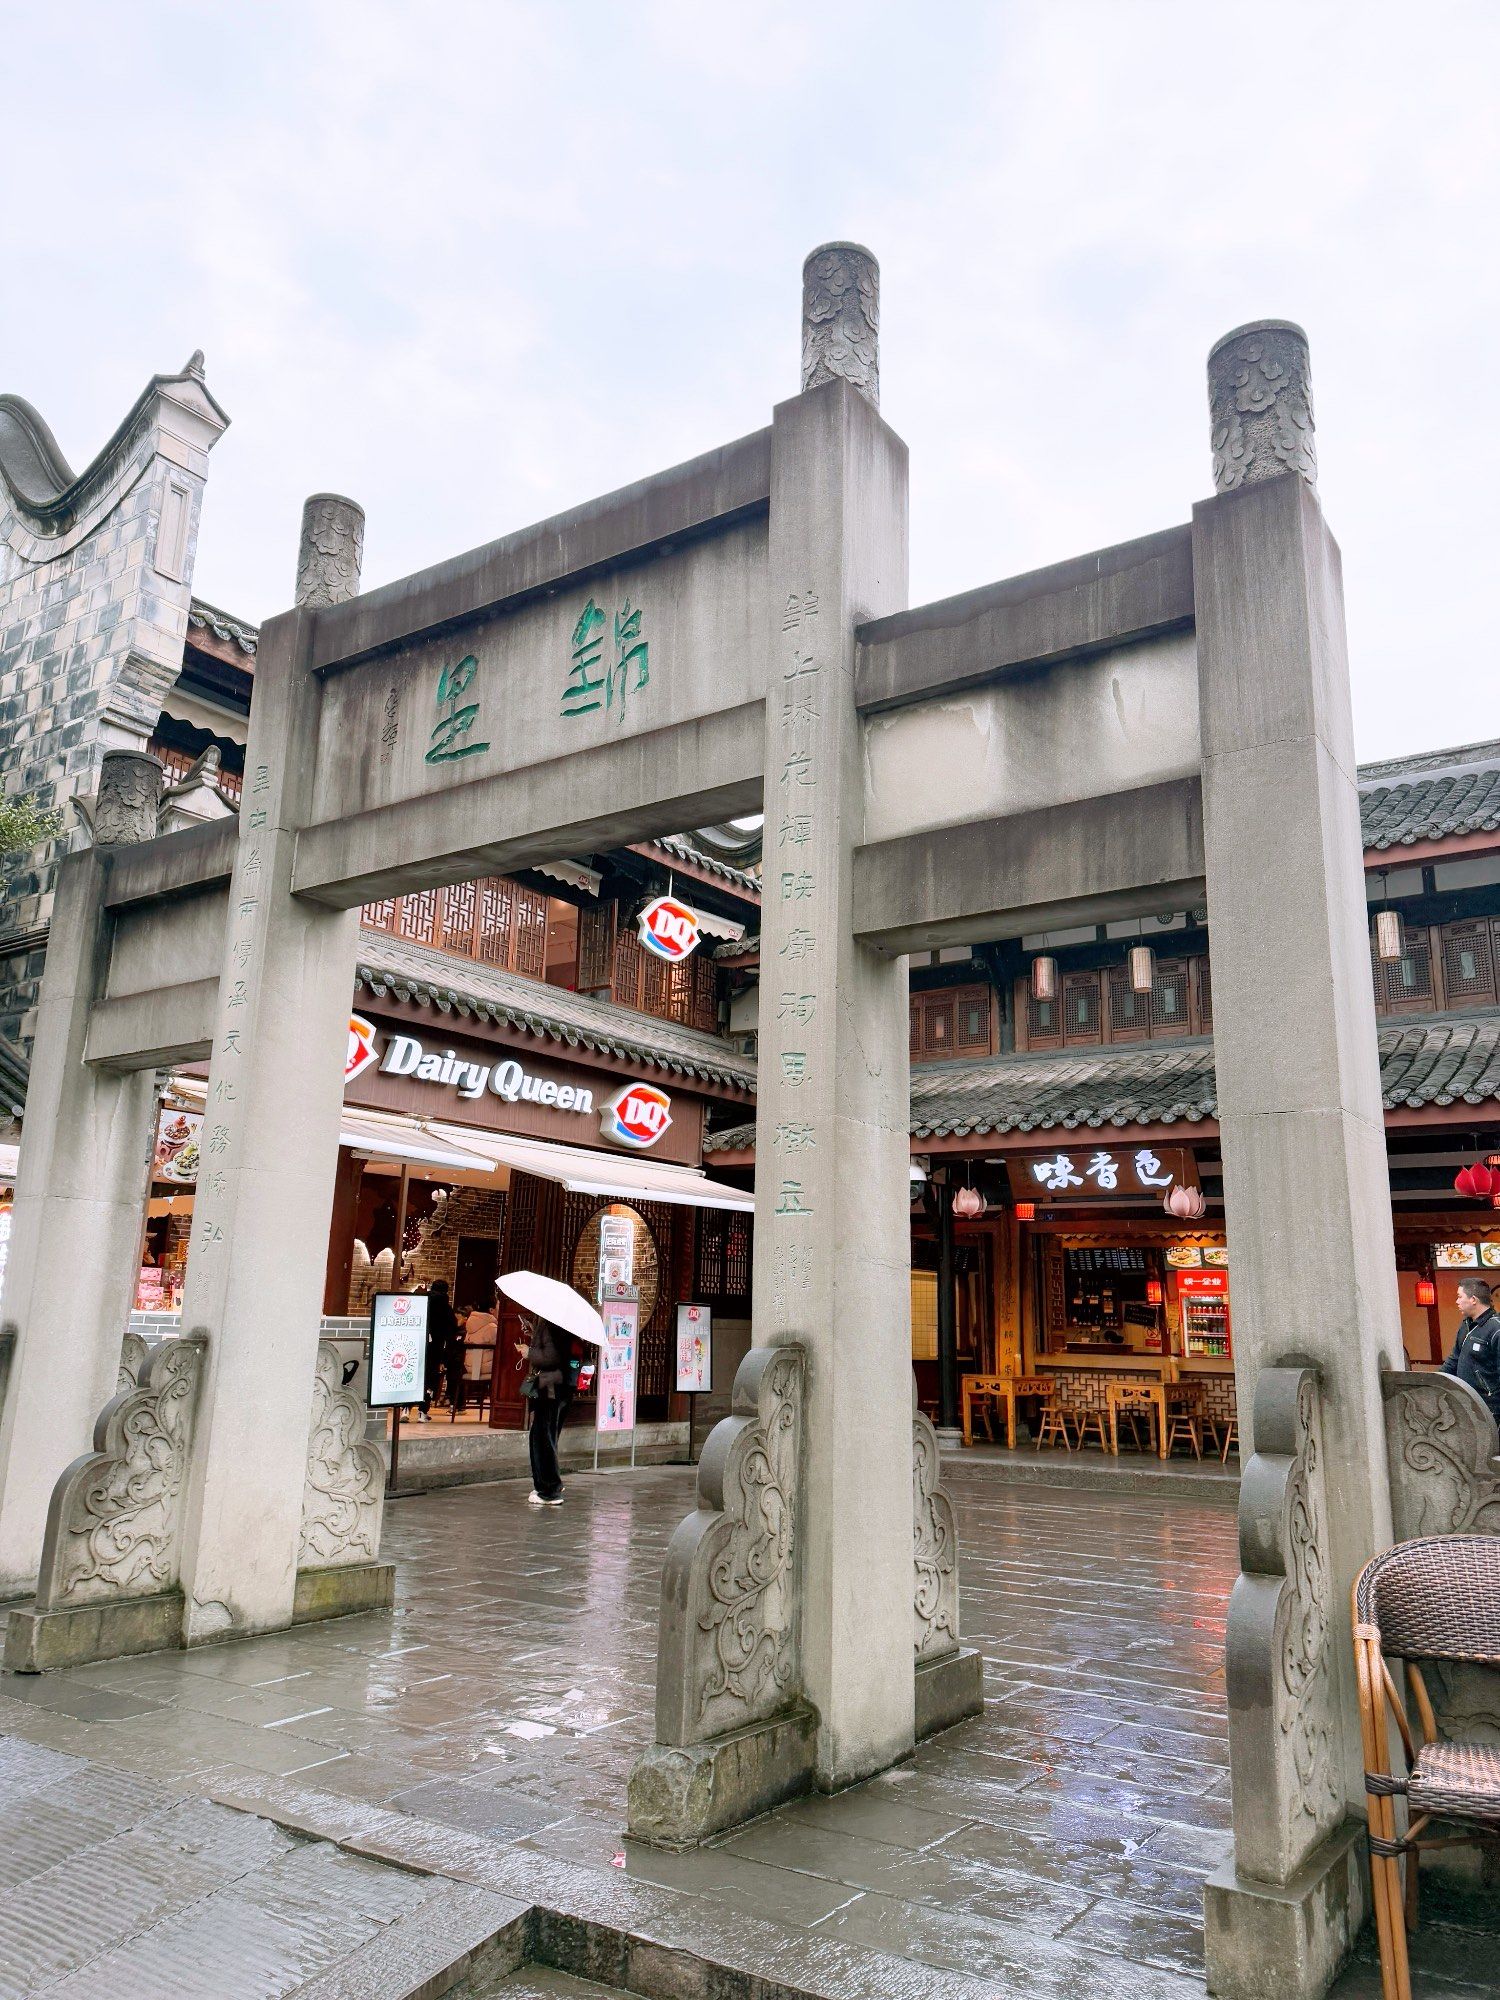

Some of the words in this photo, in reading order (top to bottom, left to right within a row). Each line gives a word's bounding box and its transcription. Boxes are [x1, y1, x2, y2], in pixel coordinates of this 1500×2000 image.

[654, 908, 692, 948] DQ
[381, 1034, 491, 1099] Dairy
[489, 1060, 594, 1115] Queen
[625, 1097, 663, 1129] DQ
